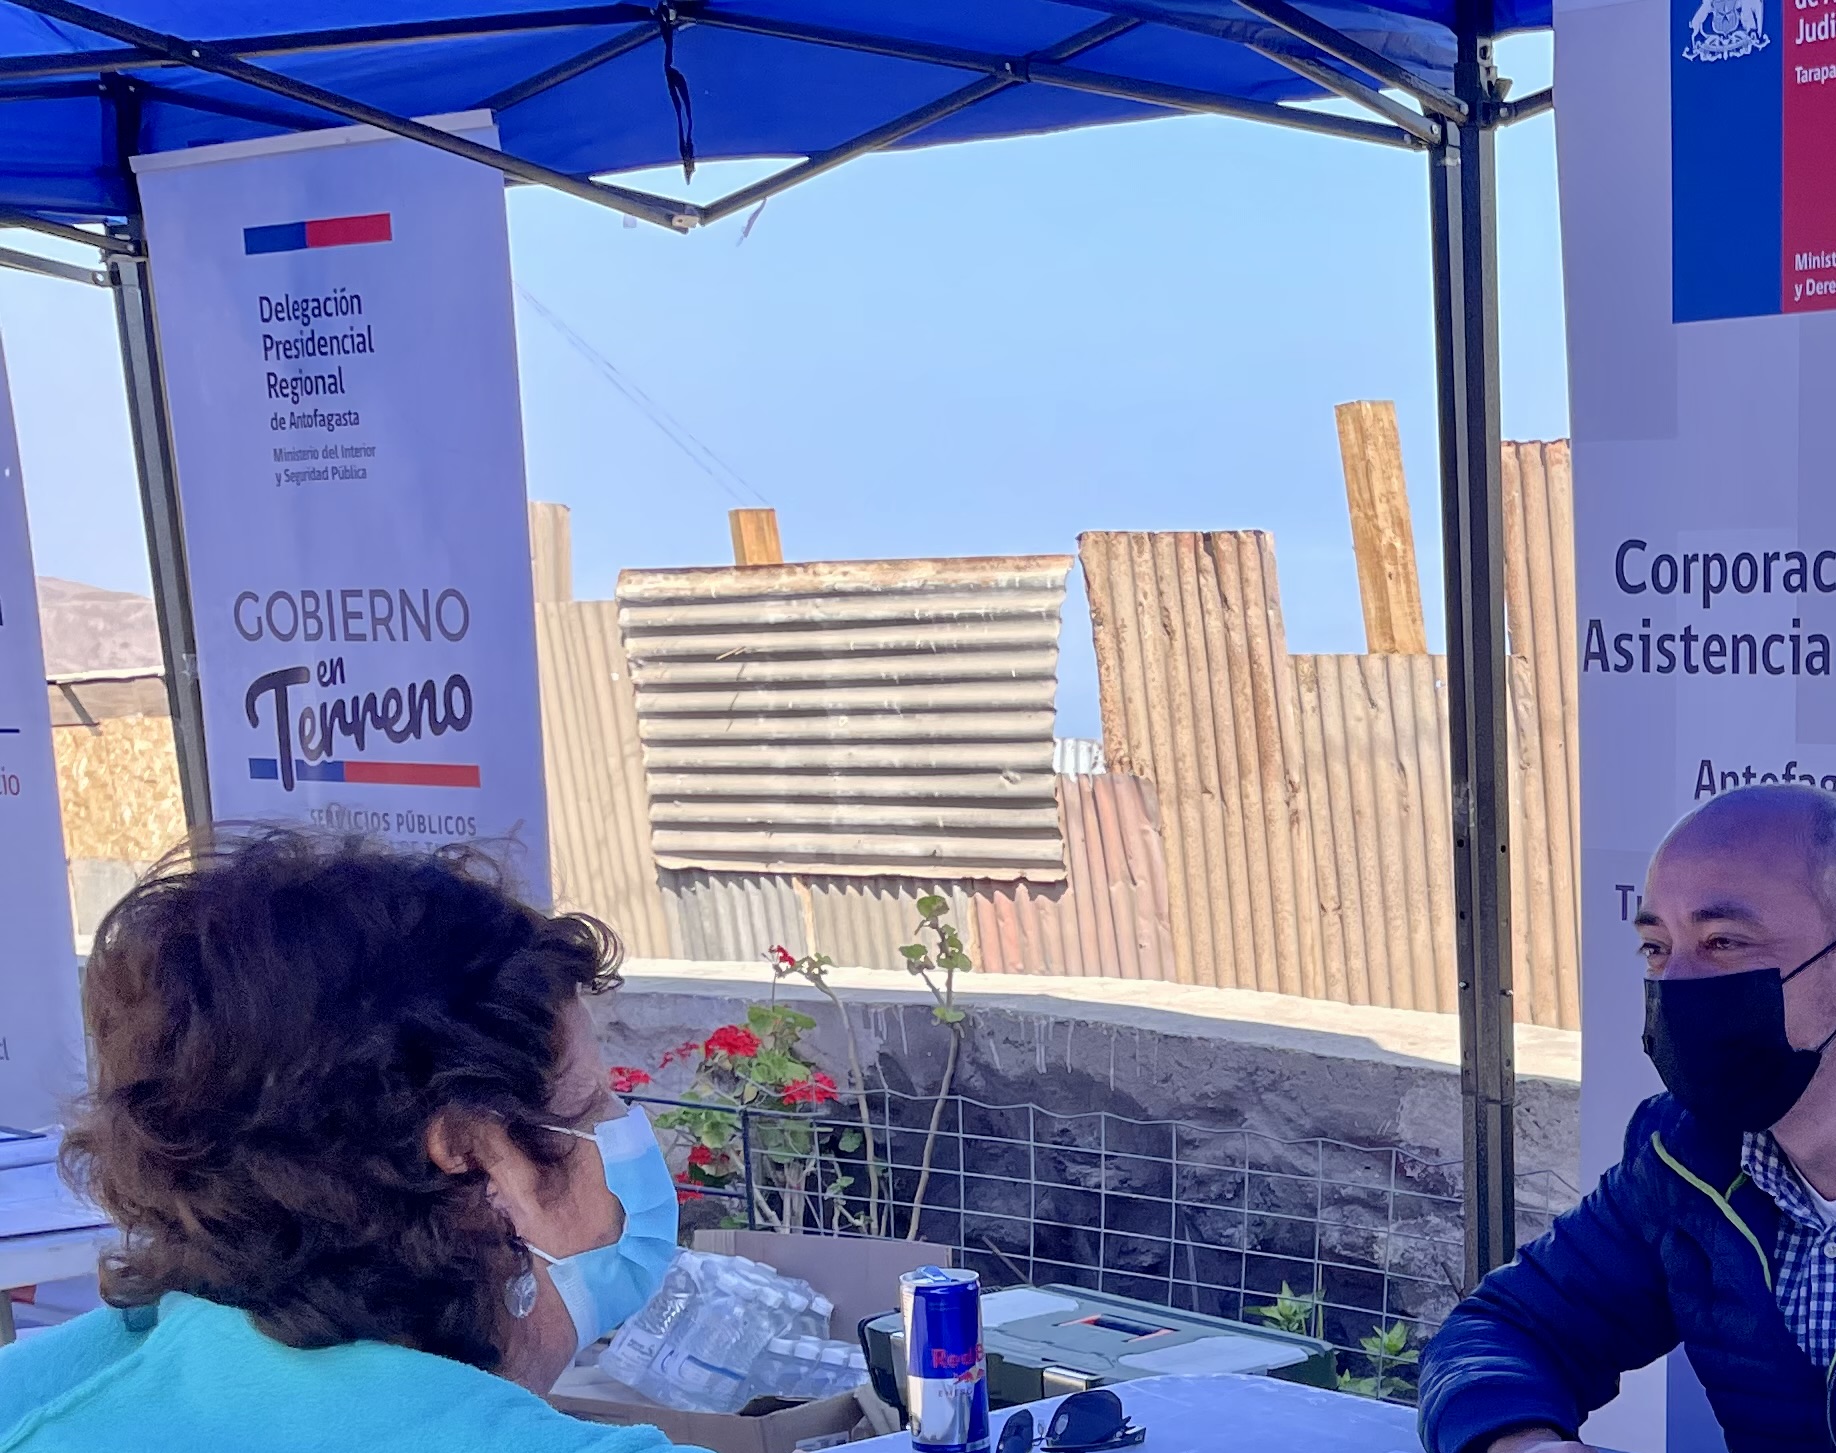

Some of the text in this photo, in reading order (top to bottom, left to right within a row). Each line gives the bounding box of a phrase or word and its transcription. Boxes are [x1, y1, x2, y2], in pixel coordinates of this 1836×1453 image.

[259, 287, 362, 326] Delegación
[1794, 282, 1803, 301] y
[262, 325, 375, 361] Presidencial
[266, 366, 345, 404] Regional
[270, 409, 360, 432] de Antofagasta
[273, 443, 376, 462] Ministerio del Interior
[275, 463, 367, 487] y Seguridad Pública
[233, 588, 470, 642] GOBIERNO
[1583, 618, 1831, 676] Asistencia
[317, 657, 345, 687] en
[245, 666, 473, 792] Terreno
[396, 810, 476, 836] PÚBLICOS
[931, 1348, 974, 1368] Red
